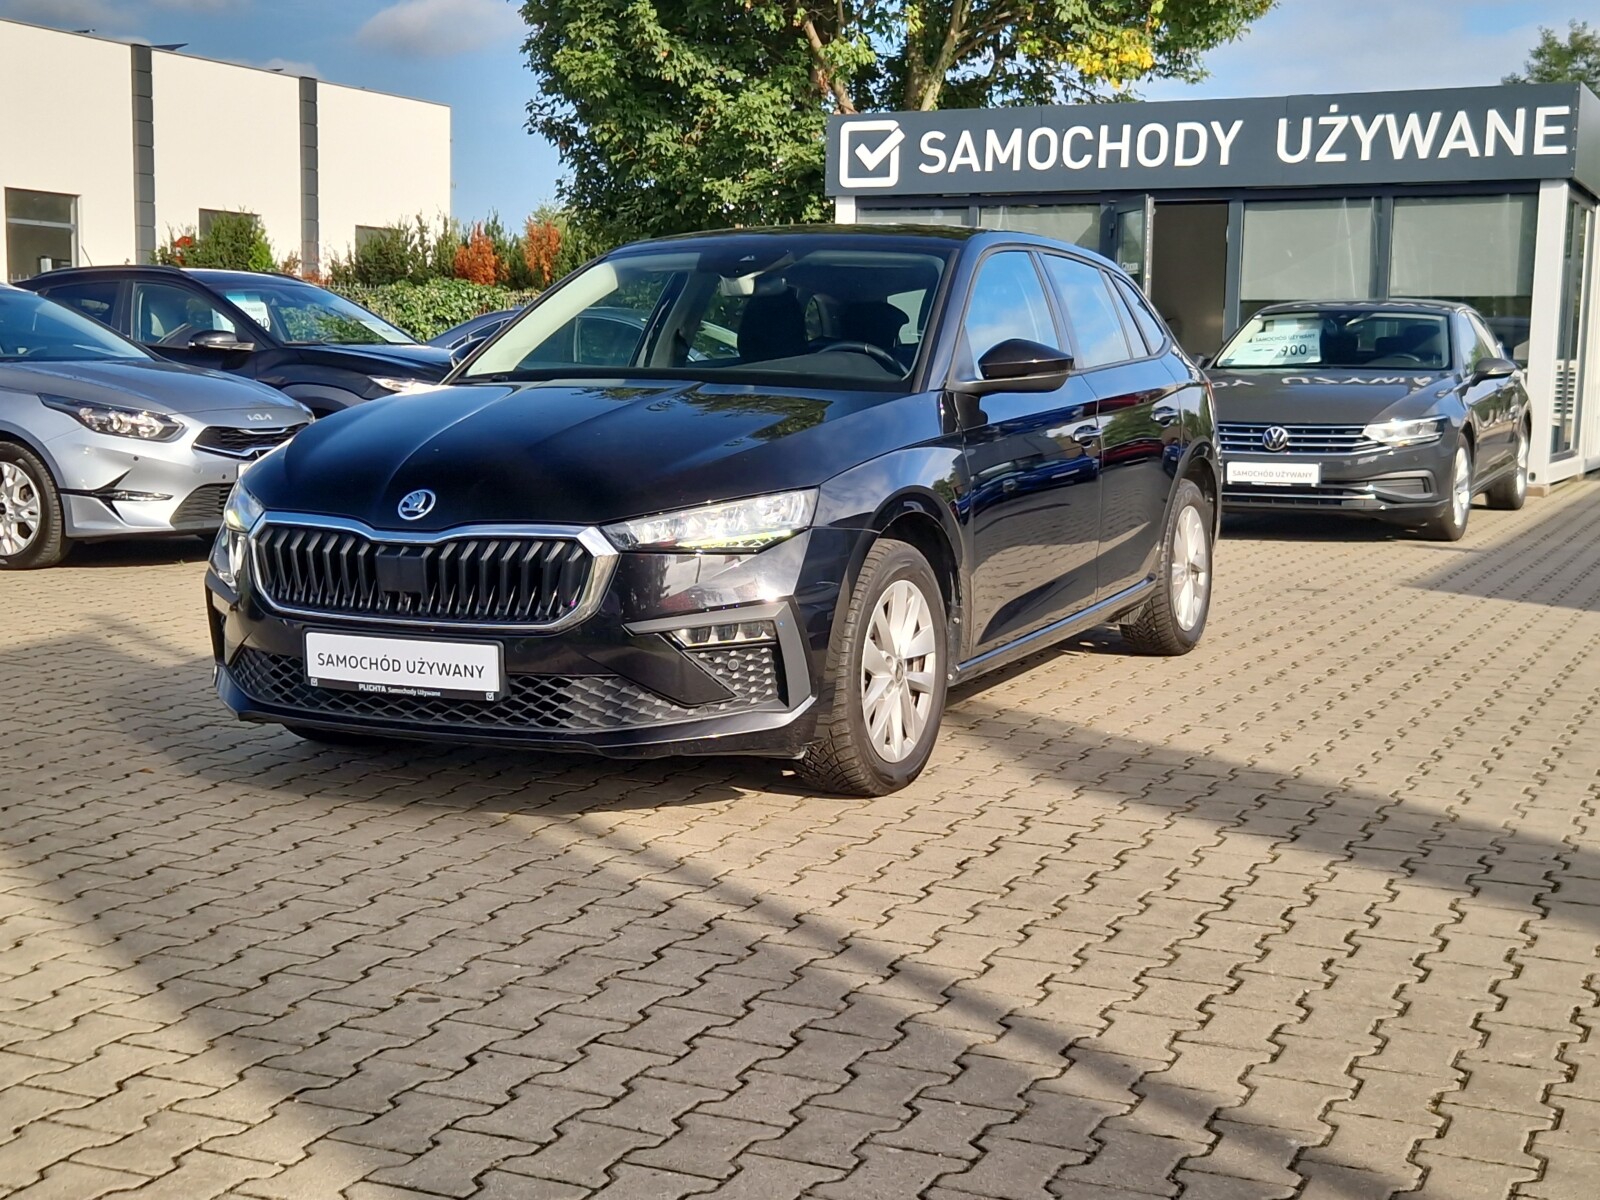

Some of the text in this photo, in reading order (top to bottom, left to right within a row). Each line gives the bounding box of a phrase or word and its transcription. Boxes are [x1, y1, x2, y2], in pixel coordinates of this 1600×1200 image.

[918, 104, 1570, 174] SAMOCHODY UŻYWANE
[1232, 469, 1313, 478] SAMOCHÓD UŻYWANY
[317, 652, 485, 679] SAMOCHÓD UŻYWANY
[358, 683, 387, 693] PLICHTA
